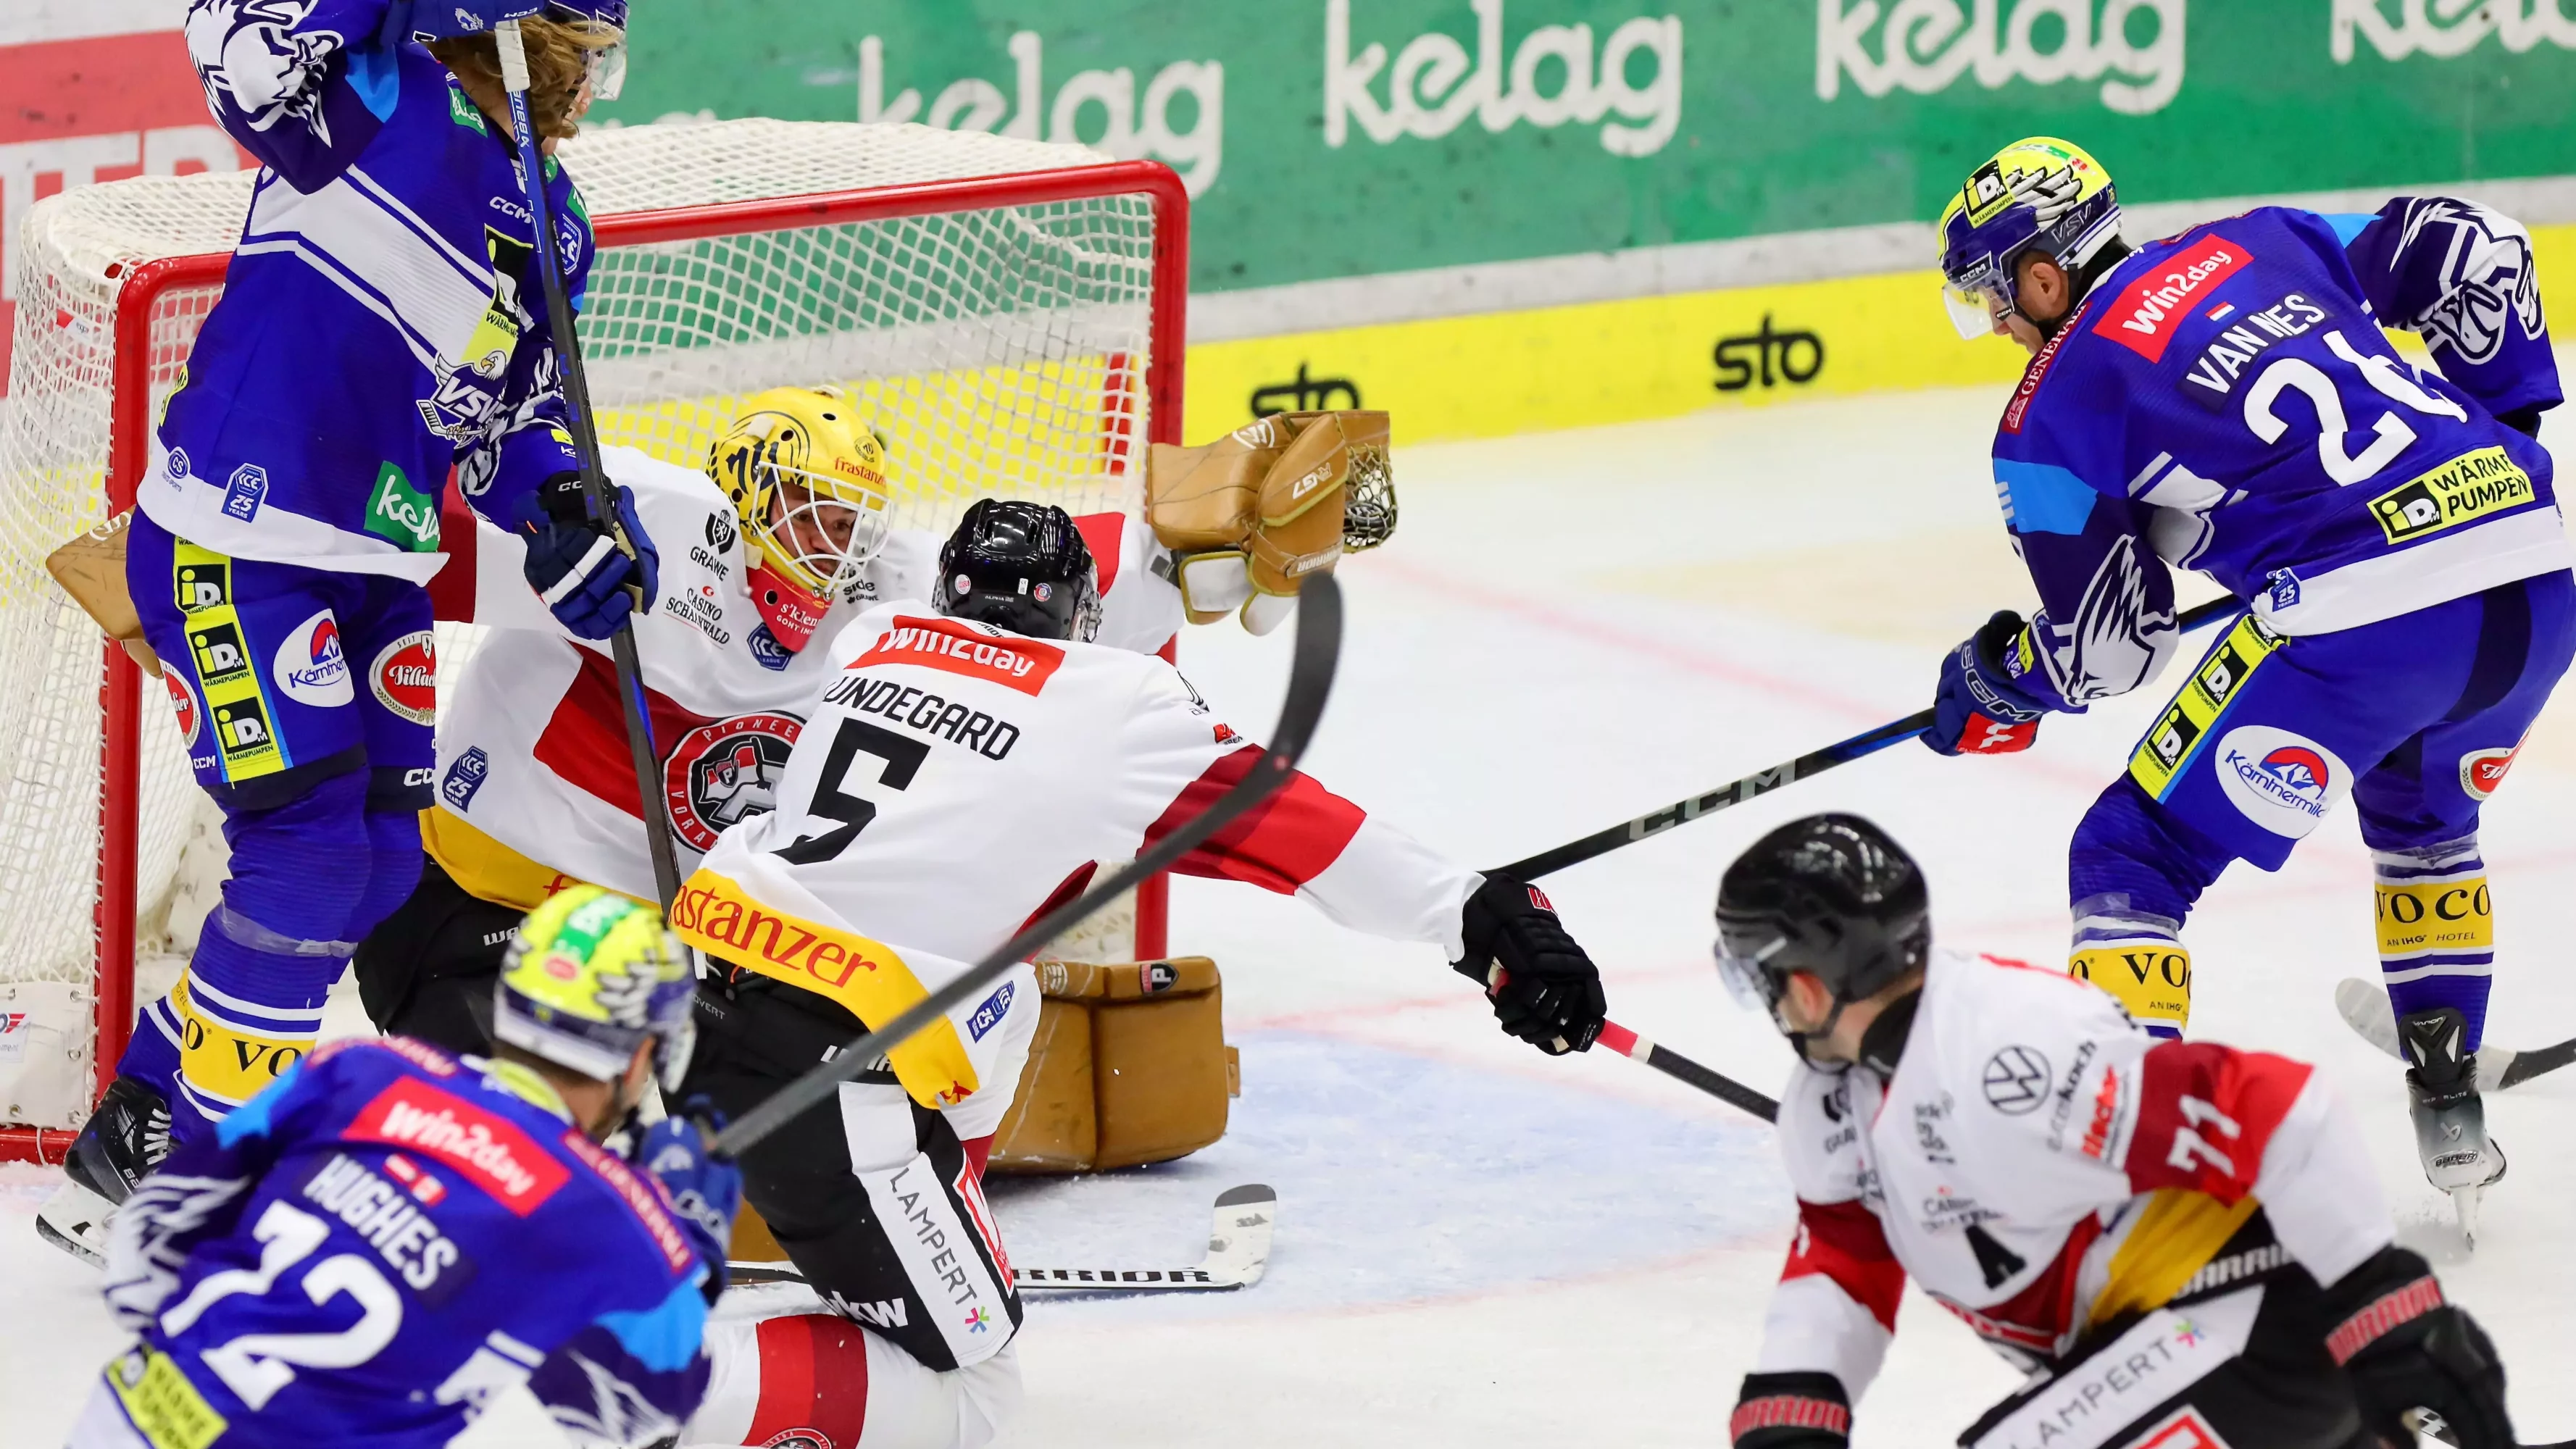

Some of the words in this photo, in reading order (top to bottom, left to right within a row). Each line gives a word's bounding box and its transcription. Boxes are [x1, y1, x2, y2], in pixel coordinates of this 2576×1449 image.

[1324, 0, 1683, 157] kelag
[858, 30, 1225, 200] kelag
[489, 196, 532, 224] CCM
[1972, 196, 2014, 225] WÄRMEPUMPEN
[2051, 202, 2093, 244] VSV
[1959, 262, 1987, 283] CCM
[2122, 249, 2233, 336] win2day
[1996, 306, 2013, 319] CCM
[1714, 310, 1824, 392] sto
[2185, 325, 2269, 394] VAN
[2247, 293, 2327, 338] NES
[437, 375, 500, 425] VSV
[1250, 365, 1362, 420] sto
[172, 457, 184, 473] CS
[238, 472, 262, 490] ICE
[2432, 452, 2515, 493] WÄRME
[228, 507, 249, 519] YEARS
[230, 494, 255, 512] 25
[375, 475, 441, 543] kela
[2447, 475, 2528, 518] PUMPEN
[690, 546, 730, 582] GRAWE
[687, 588, 723, 622] CASINO
[2277, 584, 2296, 604] 25
[193, 755, 216, 769] CCM
[462, 755, 485, 776] ICE
[446, 777, 472, 798] 25
[770, 717, 932, 866] 5
[1628, 759, 1796, 842] CCM
[2375, 884, 2490, 924] VOCO
[2387, 938, 2400, 947] AN
[2436, 932, 2476, 942] HOTEL
[977, 1007, 995, 1029] 25
[2165, 1094, 2241, 1179] 71
[302, 1155, 459, 1290] HUGHES
[889, 1166, 978, 1306] LAMPERT
[161, 1198, 404, 1411] 72
